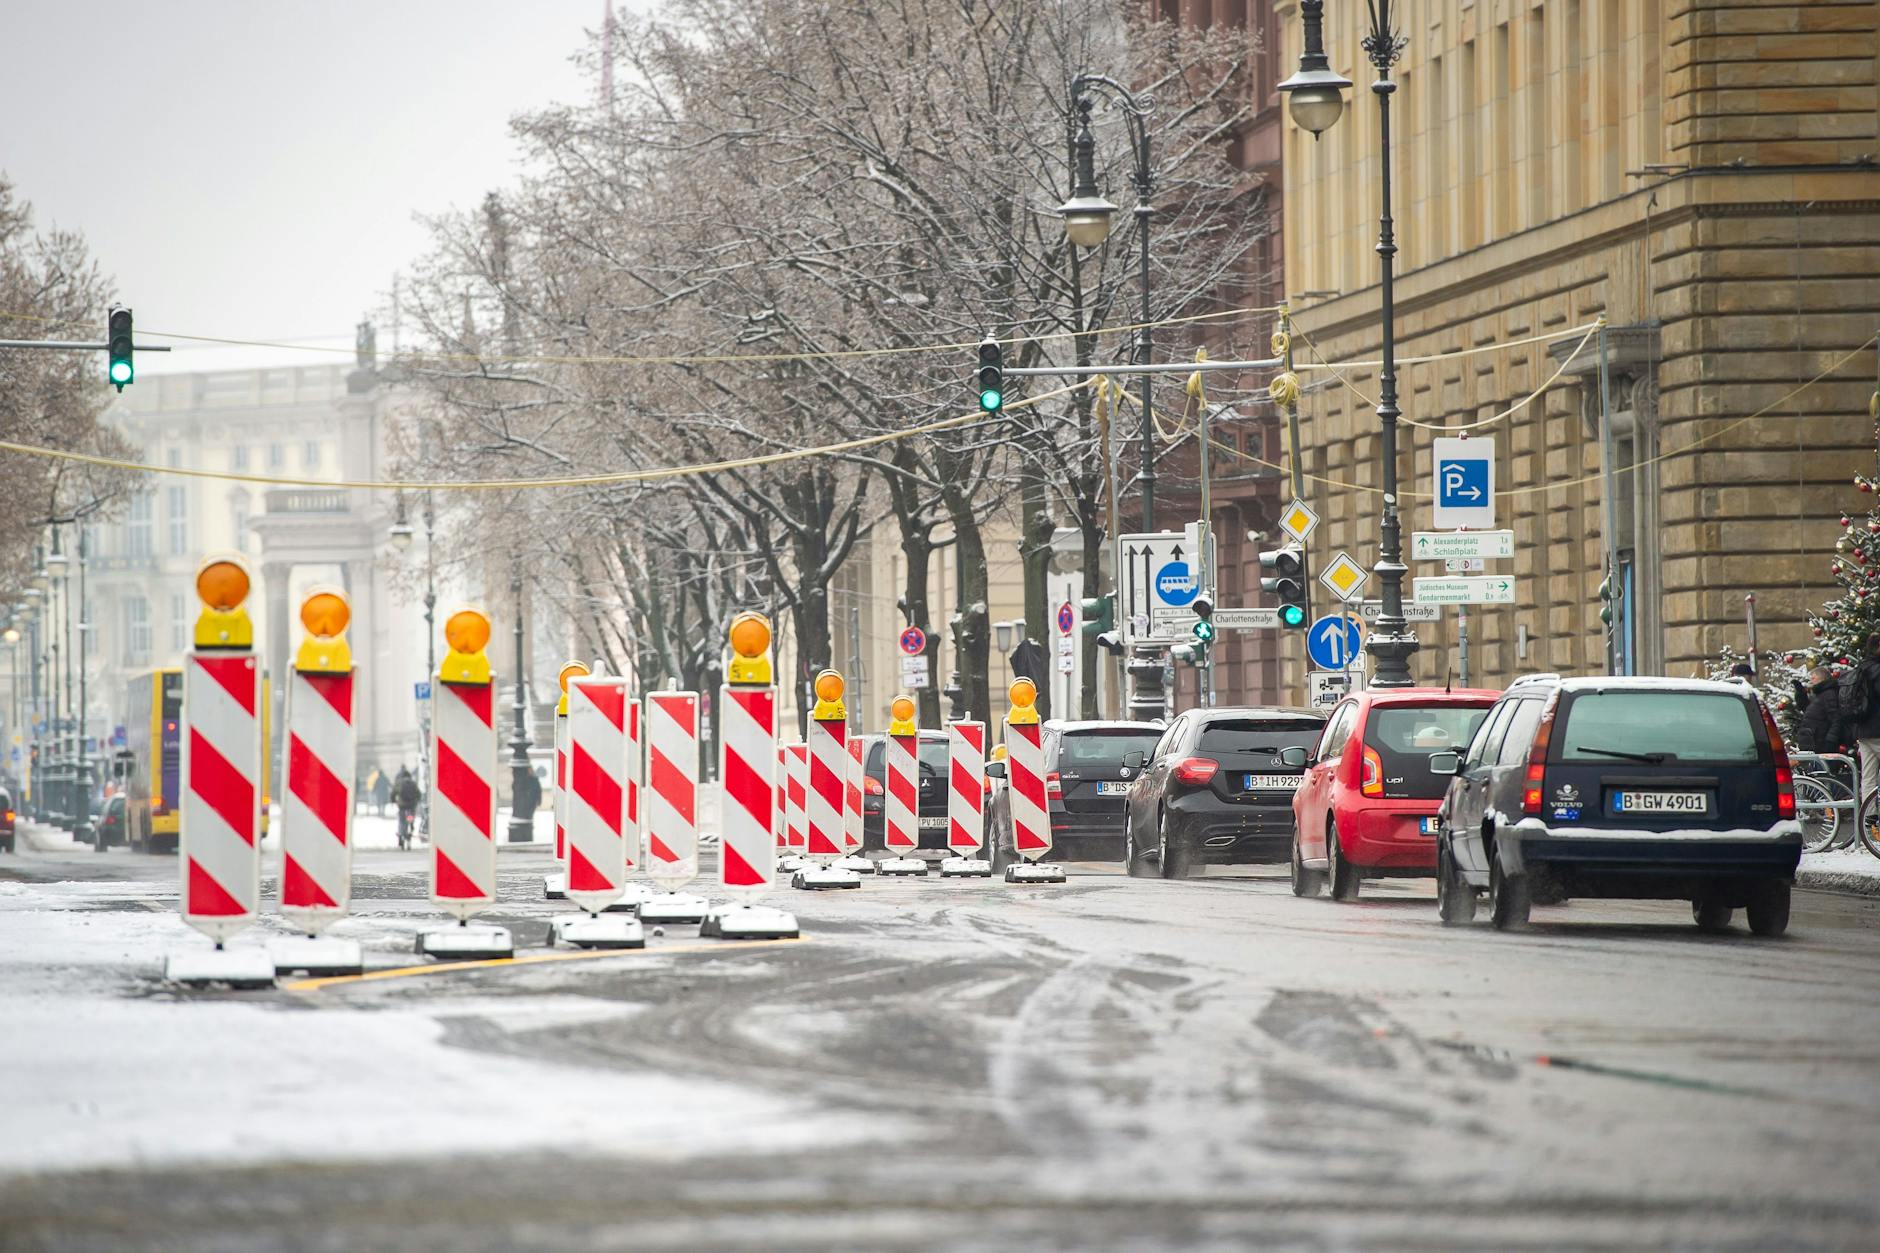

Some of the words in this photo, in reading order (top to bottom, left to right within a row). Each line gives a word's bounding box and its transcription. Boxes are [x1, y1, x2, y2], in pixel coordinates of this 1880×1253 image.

[1446, 473, 1464, 497] P
[1433, 537, 1479, 546] Alexanderplatz
[1434, 547, 1478, 556] Schloßplatz
[1419, 583, 1445, 591] Jüdisches
[1446, 583, 1469, 591] Museum
[1418, 593, 1471, 601] Gendarmenmarkt
[1364, 606, 1434, 618] Chanstraße
[1215, 613, 1273, 624] Charlottenstraße
[1251, 777, 1258, 786] B
[1266, 777, 1279, 786] IH
[1386, 776, 1404, 784] up!
[1103, 783, 1109, 791] B
[1115, 783, 1127, 791] DS
[1624, 796, 1633, 809] B
[1643, 796, 1663, 809] GW
[1666, 795, 1704, 810] 4901
